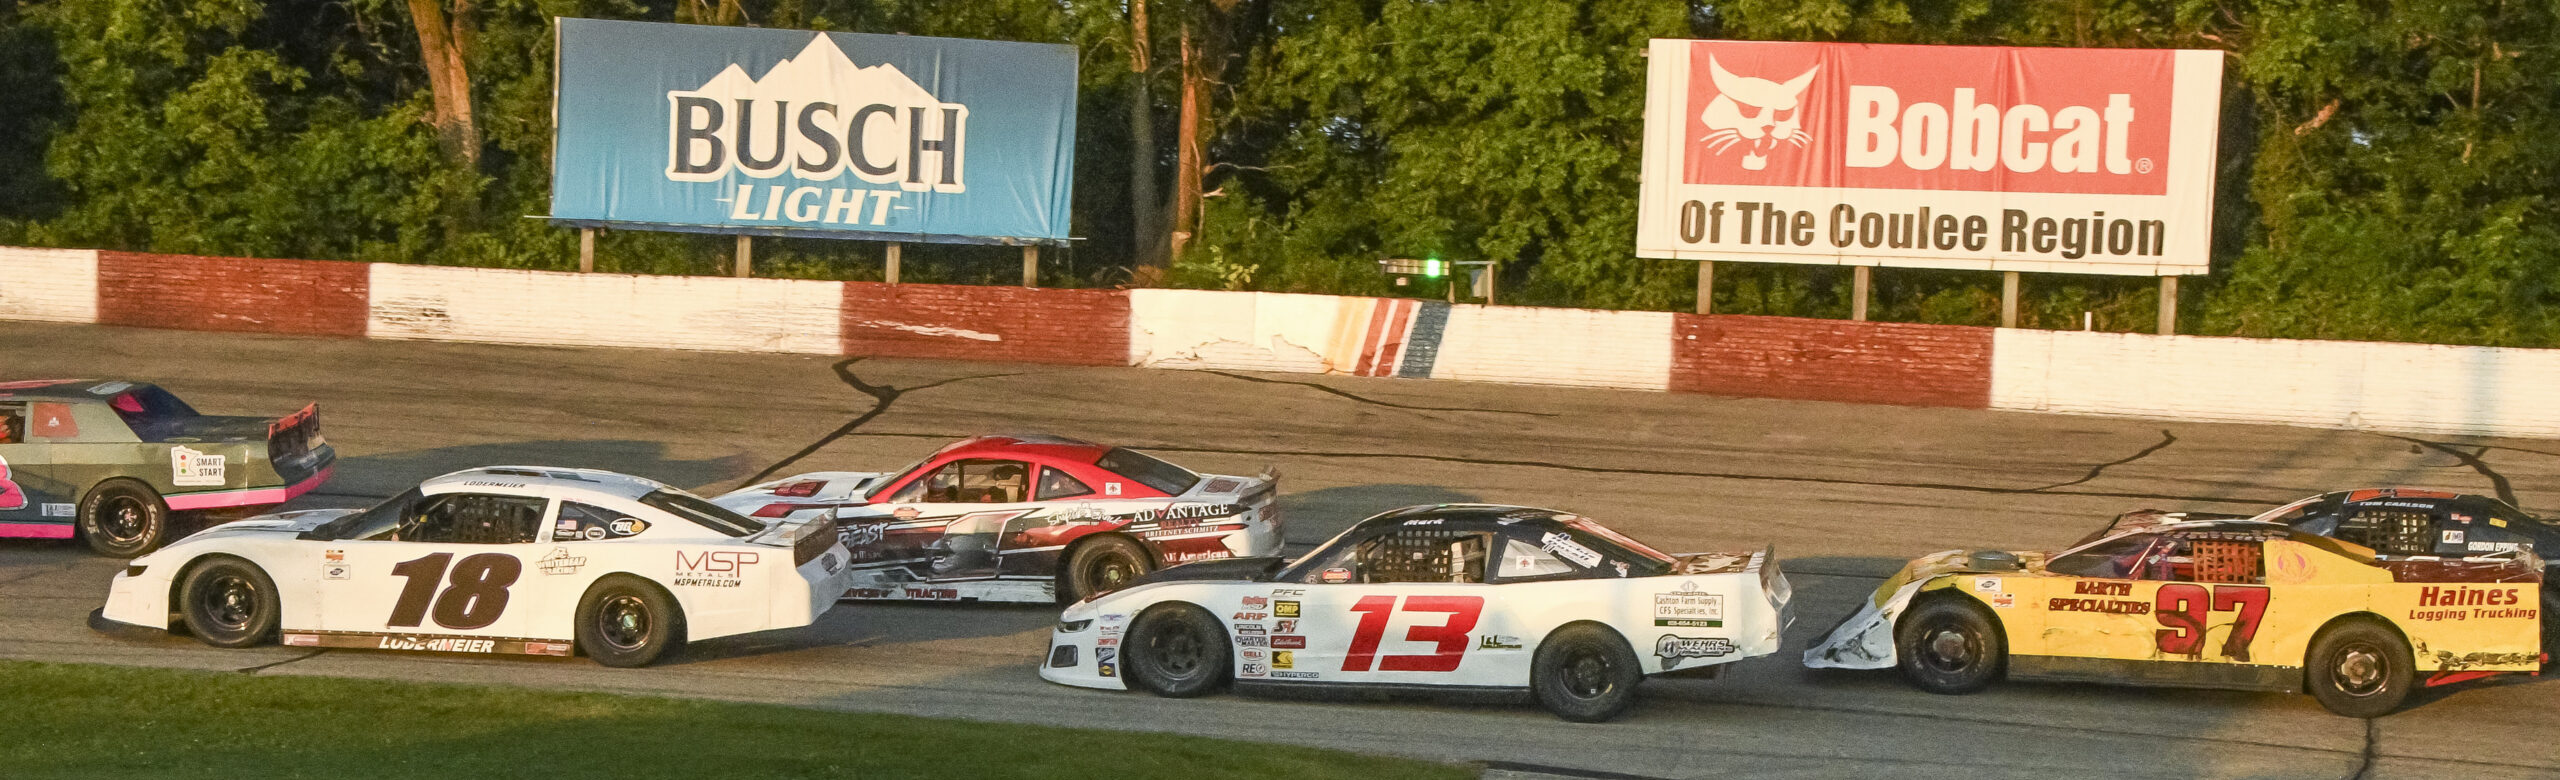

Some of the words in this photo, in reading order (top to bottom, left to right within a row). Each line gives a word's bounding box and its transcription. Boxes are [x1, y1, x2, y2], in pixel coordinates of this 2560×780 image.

[1845, 84, 2134, 175] Bobcat
[672, 96, 959, 185] BUSCH
[730, 184, 901, 225] LIGHT
[1680, 200, 1724, 244] Of
[1736, 202, 1815, 246] The
[1829, 203, 1988, 251] Coulee
[2001, 208, 2165, 260] Region
[196, 457, 222, 466] SMART
[199, 468, 222, 477] START
[1133, 502, 1230, 522] ADVANTAGE
[676, 550, 760, 578] MSP
[1179, 550, 1229, 562] American
[386, 552, 522, 629] 18
[674, 578, 742, 588] MSPMETALS.COM
[1655, 596, 1680, 605] Cashton
[1681, 596, 1696, 605] Farm
[1697, 596, 1717, 606] Supply
[2419, 586, 2519, 607] Haines
[1233, 612, 1268, 620] ARP
[1276, 605, 1299, 614] OMP
[1659, 606, 1672, 615] CFS
[2409, 608, 2467, 622] Logging
[2473, 607, 2537, 620] Trucking
[2156, 583, 2271, 662] 97
[1341, 595, 1485, 672] 13
